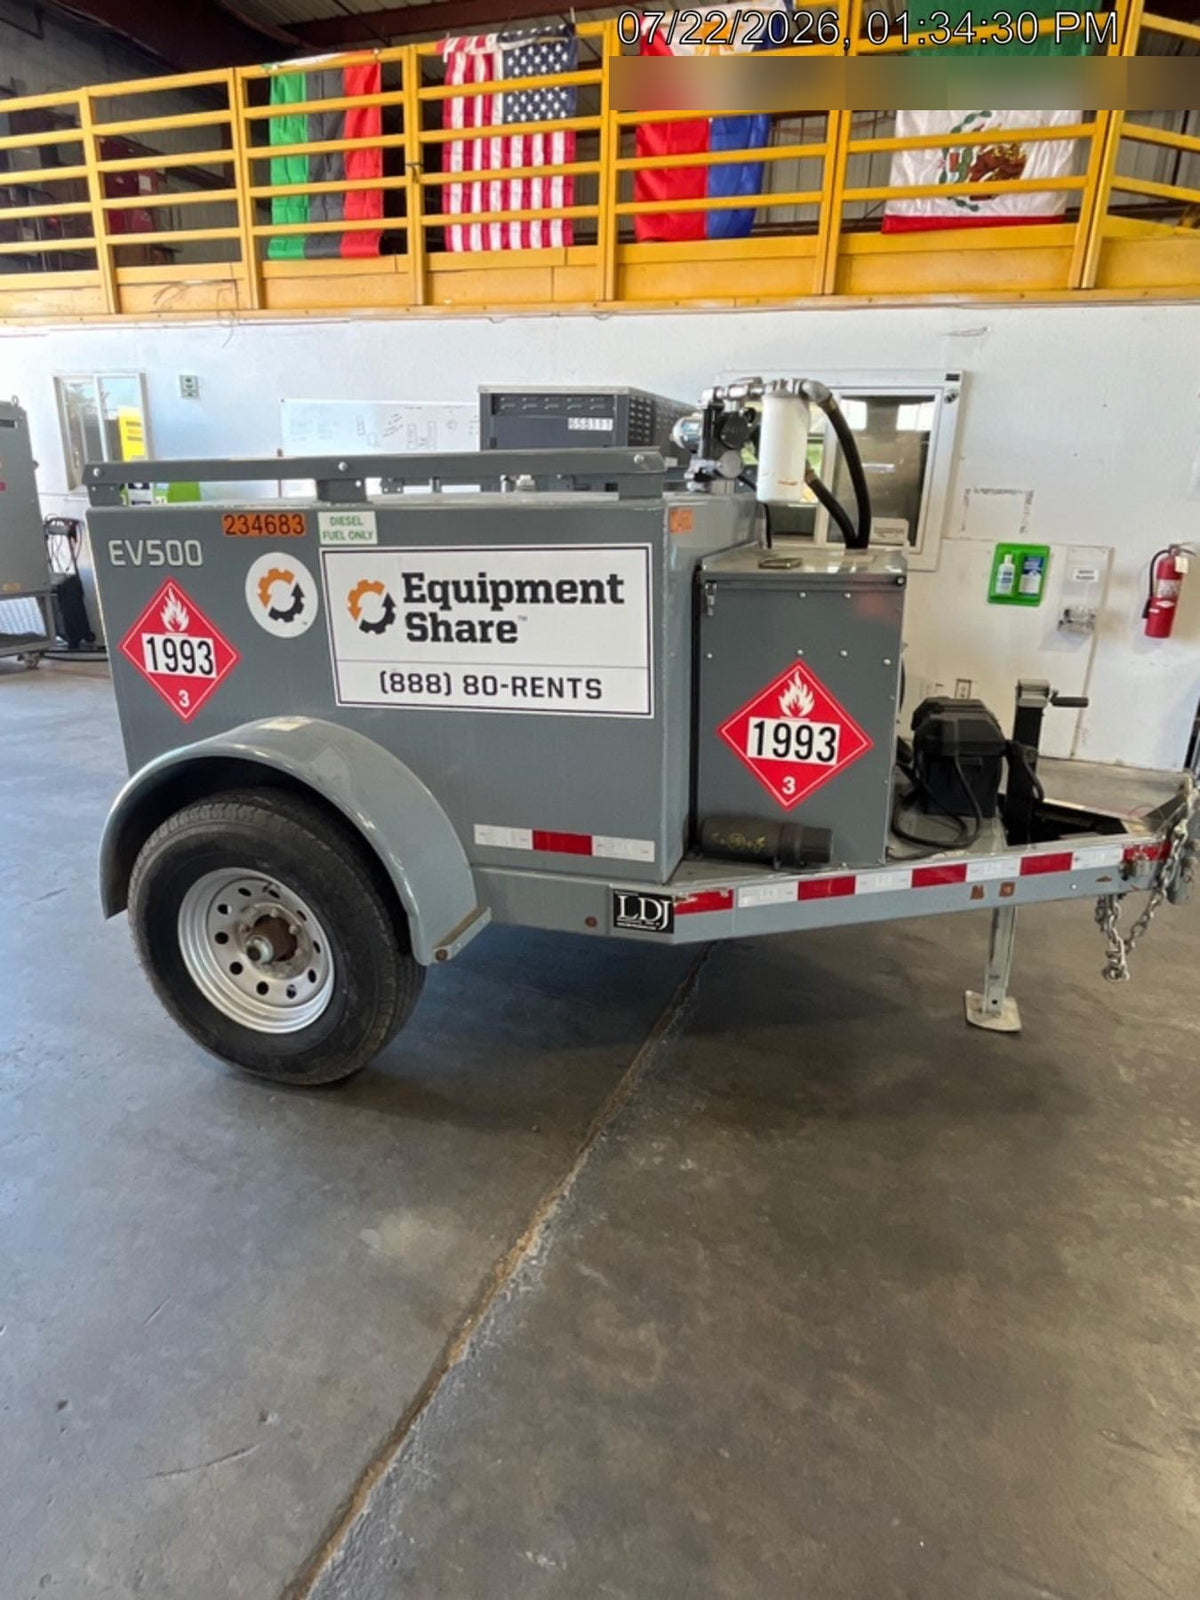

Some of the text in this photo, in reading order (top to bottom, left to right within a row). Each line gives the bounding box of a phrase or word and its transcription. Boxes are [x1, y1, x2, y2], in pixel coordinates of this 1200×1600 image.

[223, 513, 306, 537] 234683
[322, 530, 374, 541] FUEL ONLY
[329, 515, 364, 527] DIESEL
[107, 539, 204, 567] EV500
[401, 572, 625, 612] Equipment
[405, 611, 518, 645] Share
[146, 635, 214, 676] 1993
[178, 689, 191, 708] 3
[379, 670, 603, 700] (888) 80-RENTS
[752, 719, 837, 764] 1993
[781, 775, 797, 795] 3
[617, 895, 672, 931] LDJ
